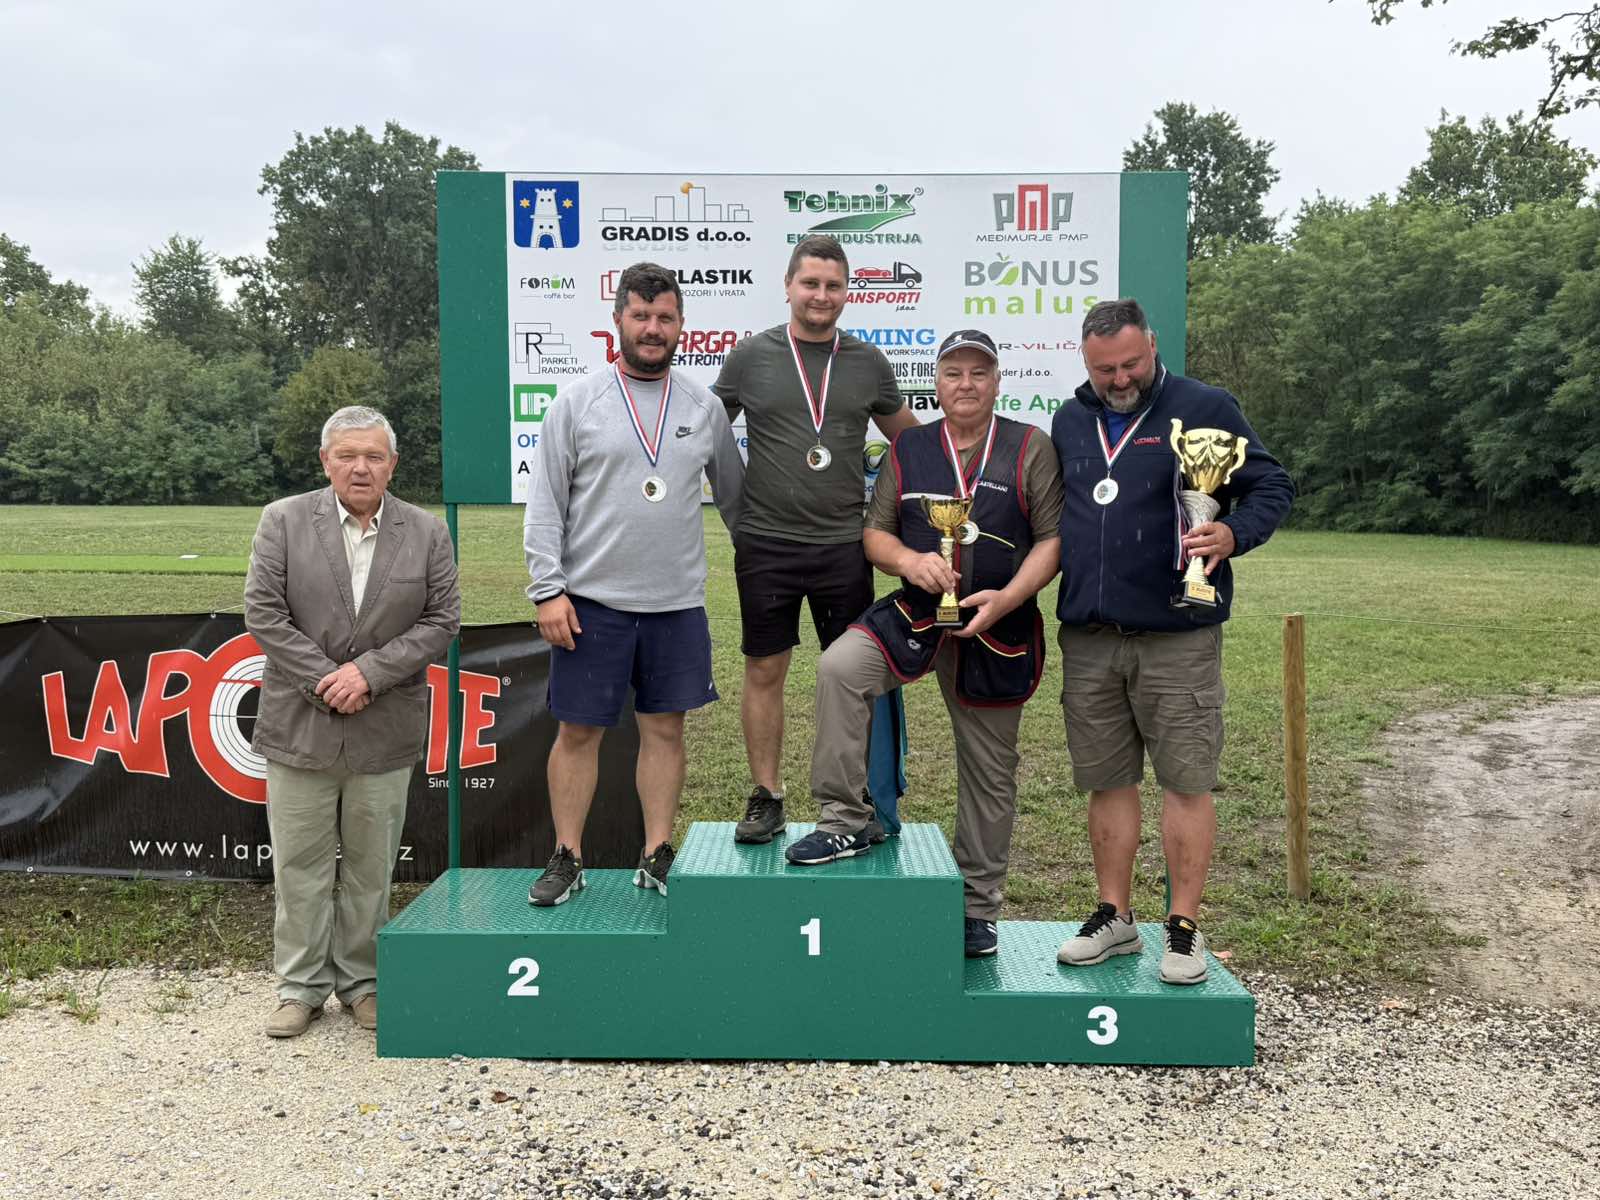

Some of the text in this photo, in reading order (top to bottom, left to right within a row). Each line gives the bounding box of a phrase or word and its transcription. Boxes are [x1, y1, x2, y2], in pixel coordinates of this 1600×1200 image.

[784, 184, 915, 213] Tehnix
[601, 226, 751, 242] GRADIS d.o.o.
[1059, 233, 1089, 241] PMP
[964, 259, 1099, 287] BONUS
[719, 289, 746, 297] VRATA
[847, 292, 920, 303] ANSPORTI
[678, 331, 737, 353] ARGA
[998, 340, 1082, 351] R-VILIČ
[541, 357, 578, 365] PARKETI
[911, 363, 936, 377] FORE
[1019, 368, 1053, 378] j.d.o.o.
[1029, 395, 1063, 415] Ap
[42, 631, 500, 804] LAPOTE
[465, 777, 495, 788] 1927
[800, 918, 821, 956] 1
[507, 957, 540, 997] 2
[1086, 1006, 1119, 1045] 3
